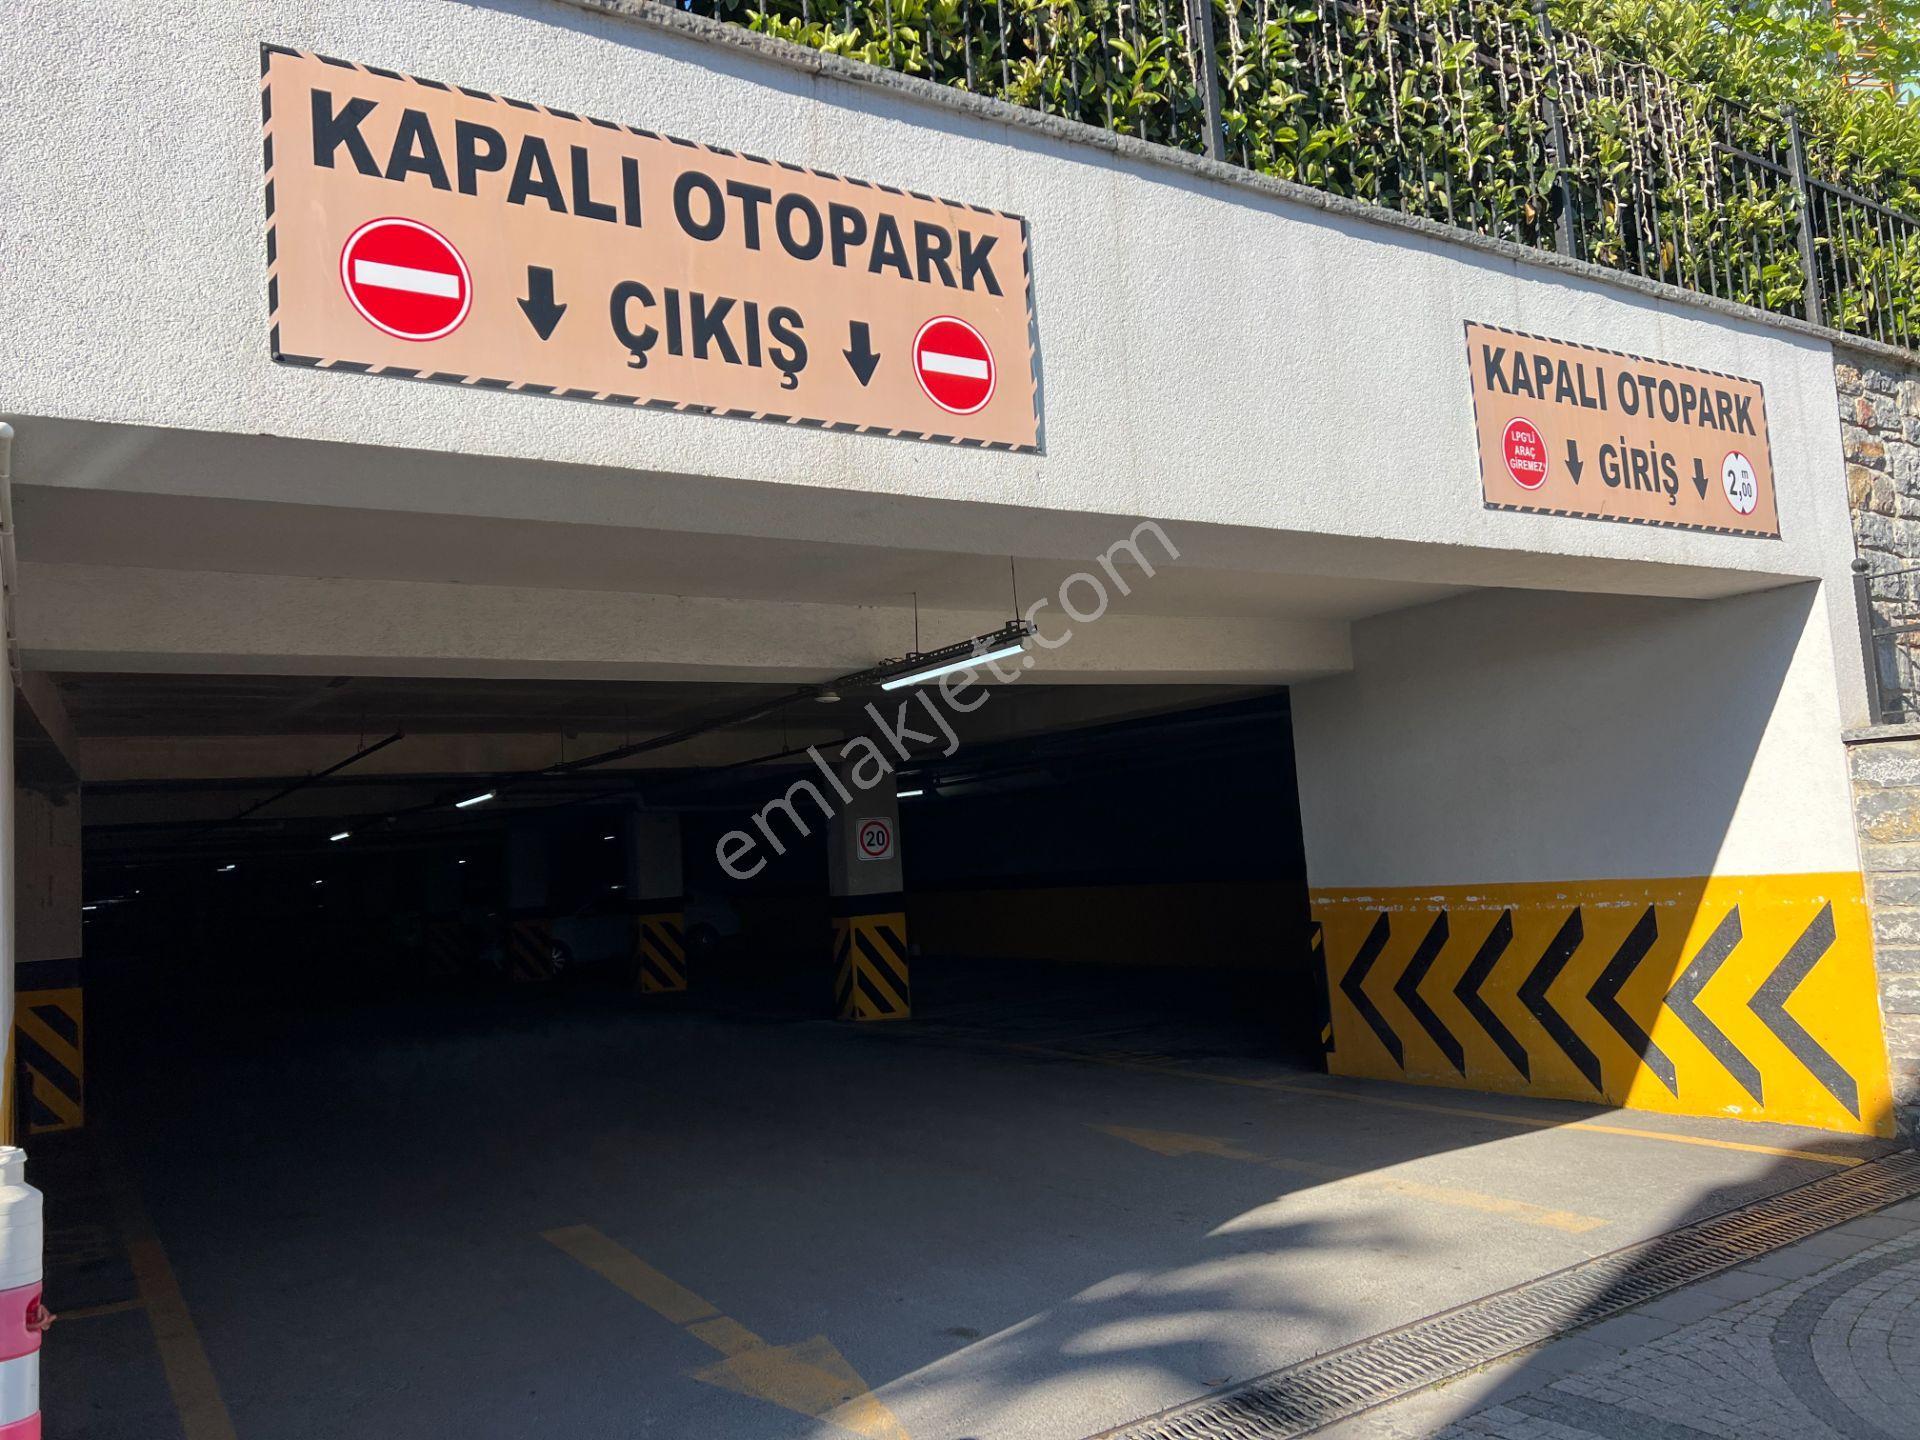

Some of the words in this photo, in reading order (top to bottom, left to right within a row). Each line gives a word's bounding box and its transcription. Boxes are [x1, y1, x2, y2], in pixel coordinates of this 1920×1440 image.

[310, 88, 643, 229] KAPALI
[672, 170, 1005, 296] OTOPARK
[609, 280, 810, 390] ÇIKIŞ
[1482, 344, 1608, 411] KAPALI
[1617, 371, 1756, 436] OTOPARK
[1509, 457, 1544, 473] GİREMEZ
[1515, 445, 1536, 460] ARAÇ
[1598, 436, 1679, 506] GİRİŞ
[866, 830, 886, 847] 20
